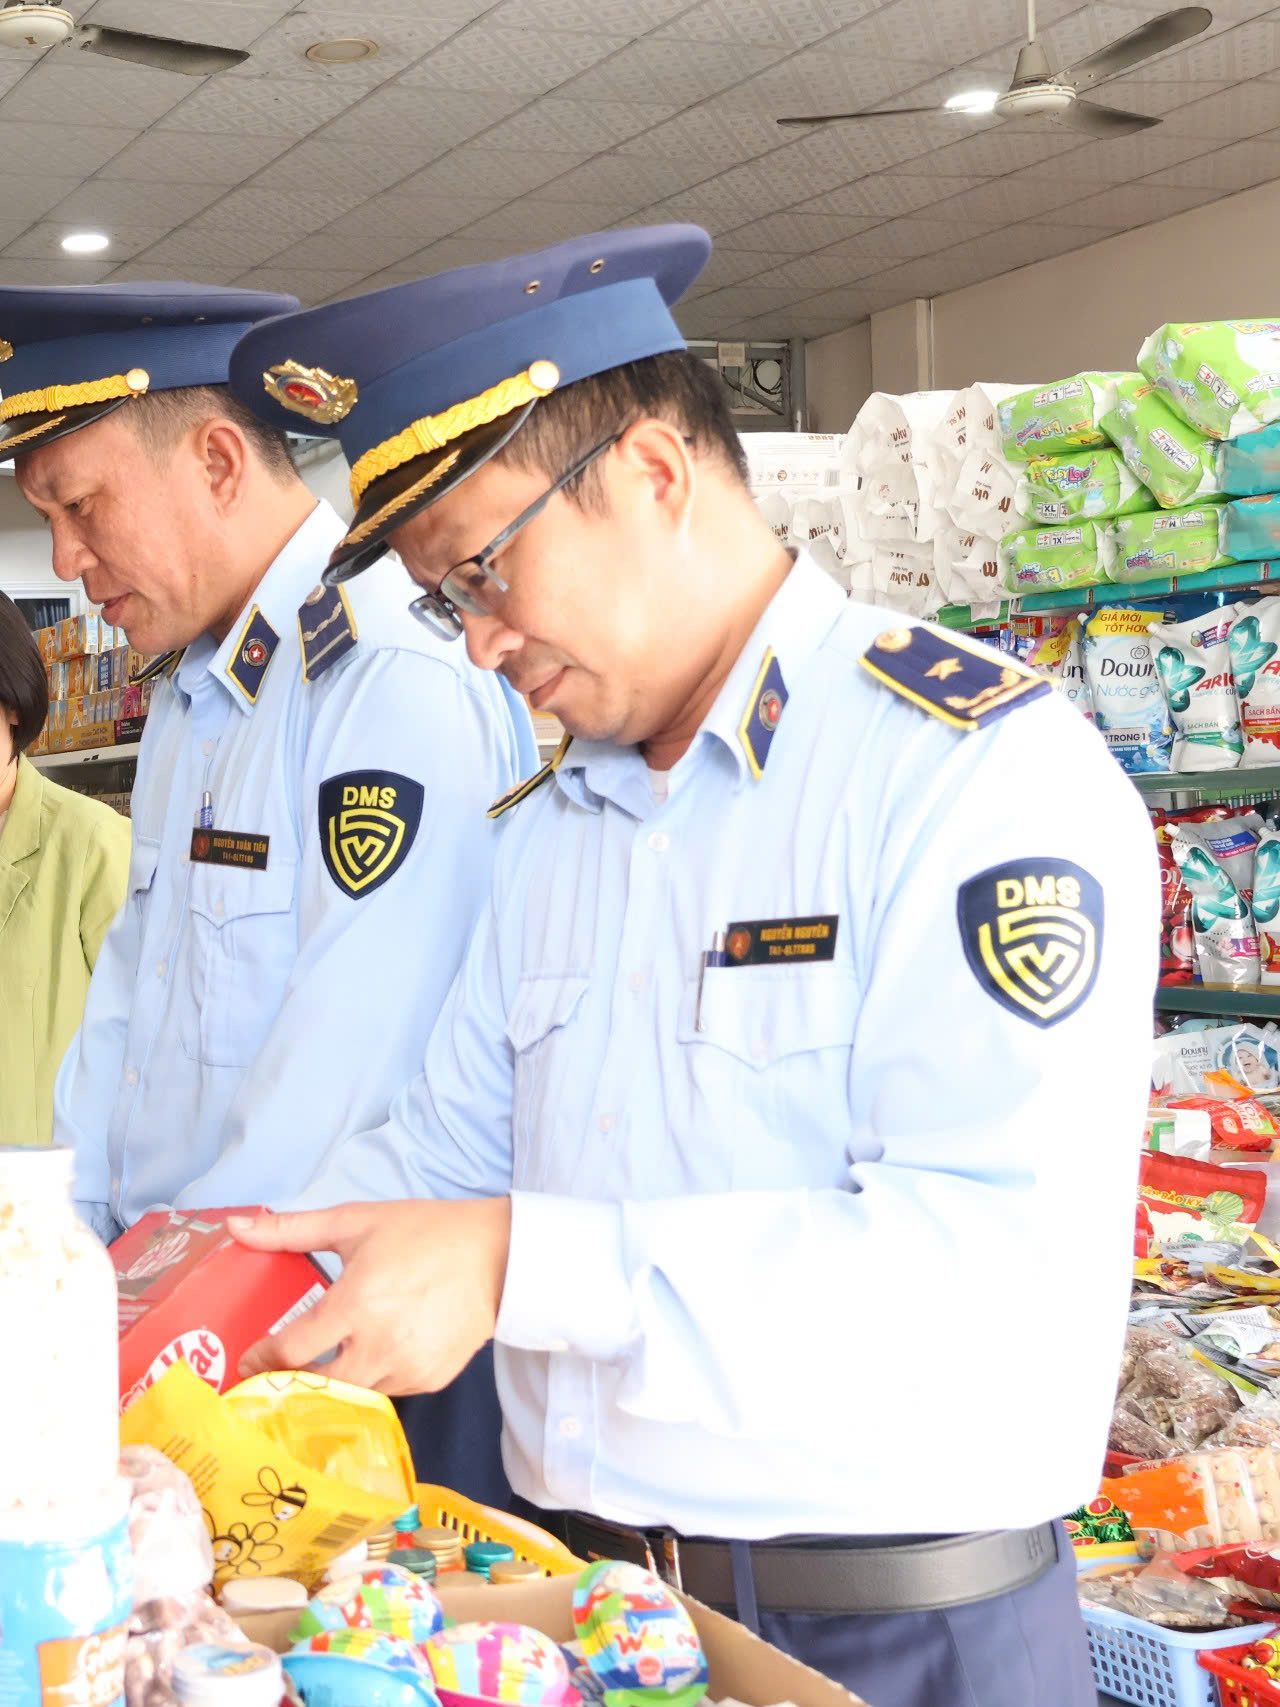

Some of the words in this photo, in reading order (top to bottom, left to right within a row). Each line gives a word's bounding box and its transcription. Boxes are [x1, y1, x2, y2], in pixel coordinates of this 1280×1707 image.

[1100, 612, 1118, 622] GIÁ
[1120, 613, 1142, 622] MỚI
[1100, 658, 1155, 678] Dow
[1109, 733, 1140, 743] TRONG
[342, 785, 397, 809] DMS
[995, 875, 1082, 910] DMS
[1181, 1046, 1208, 1056] Downy
